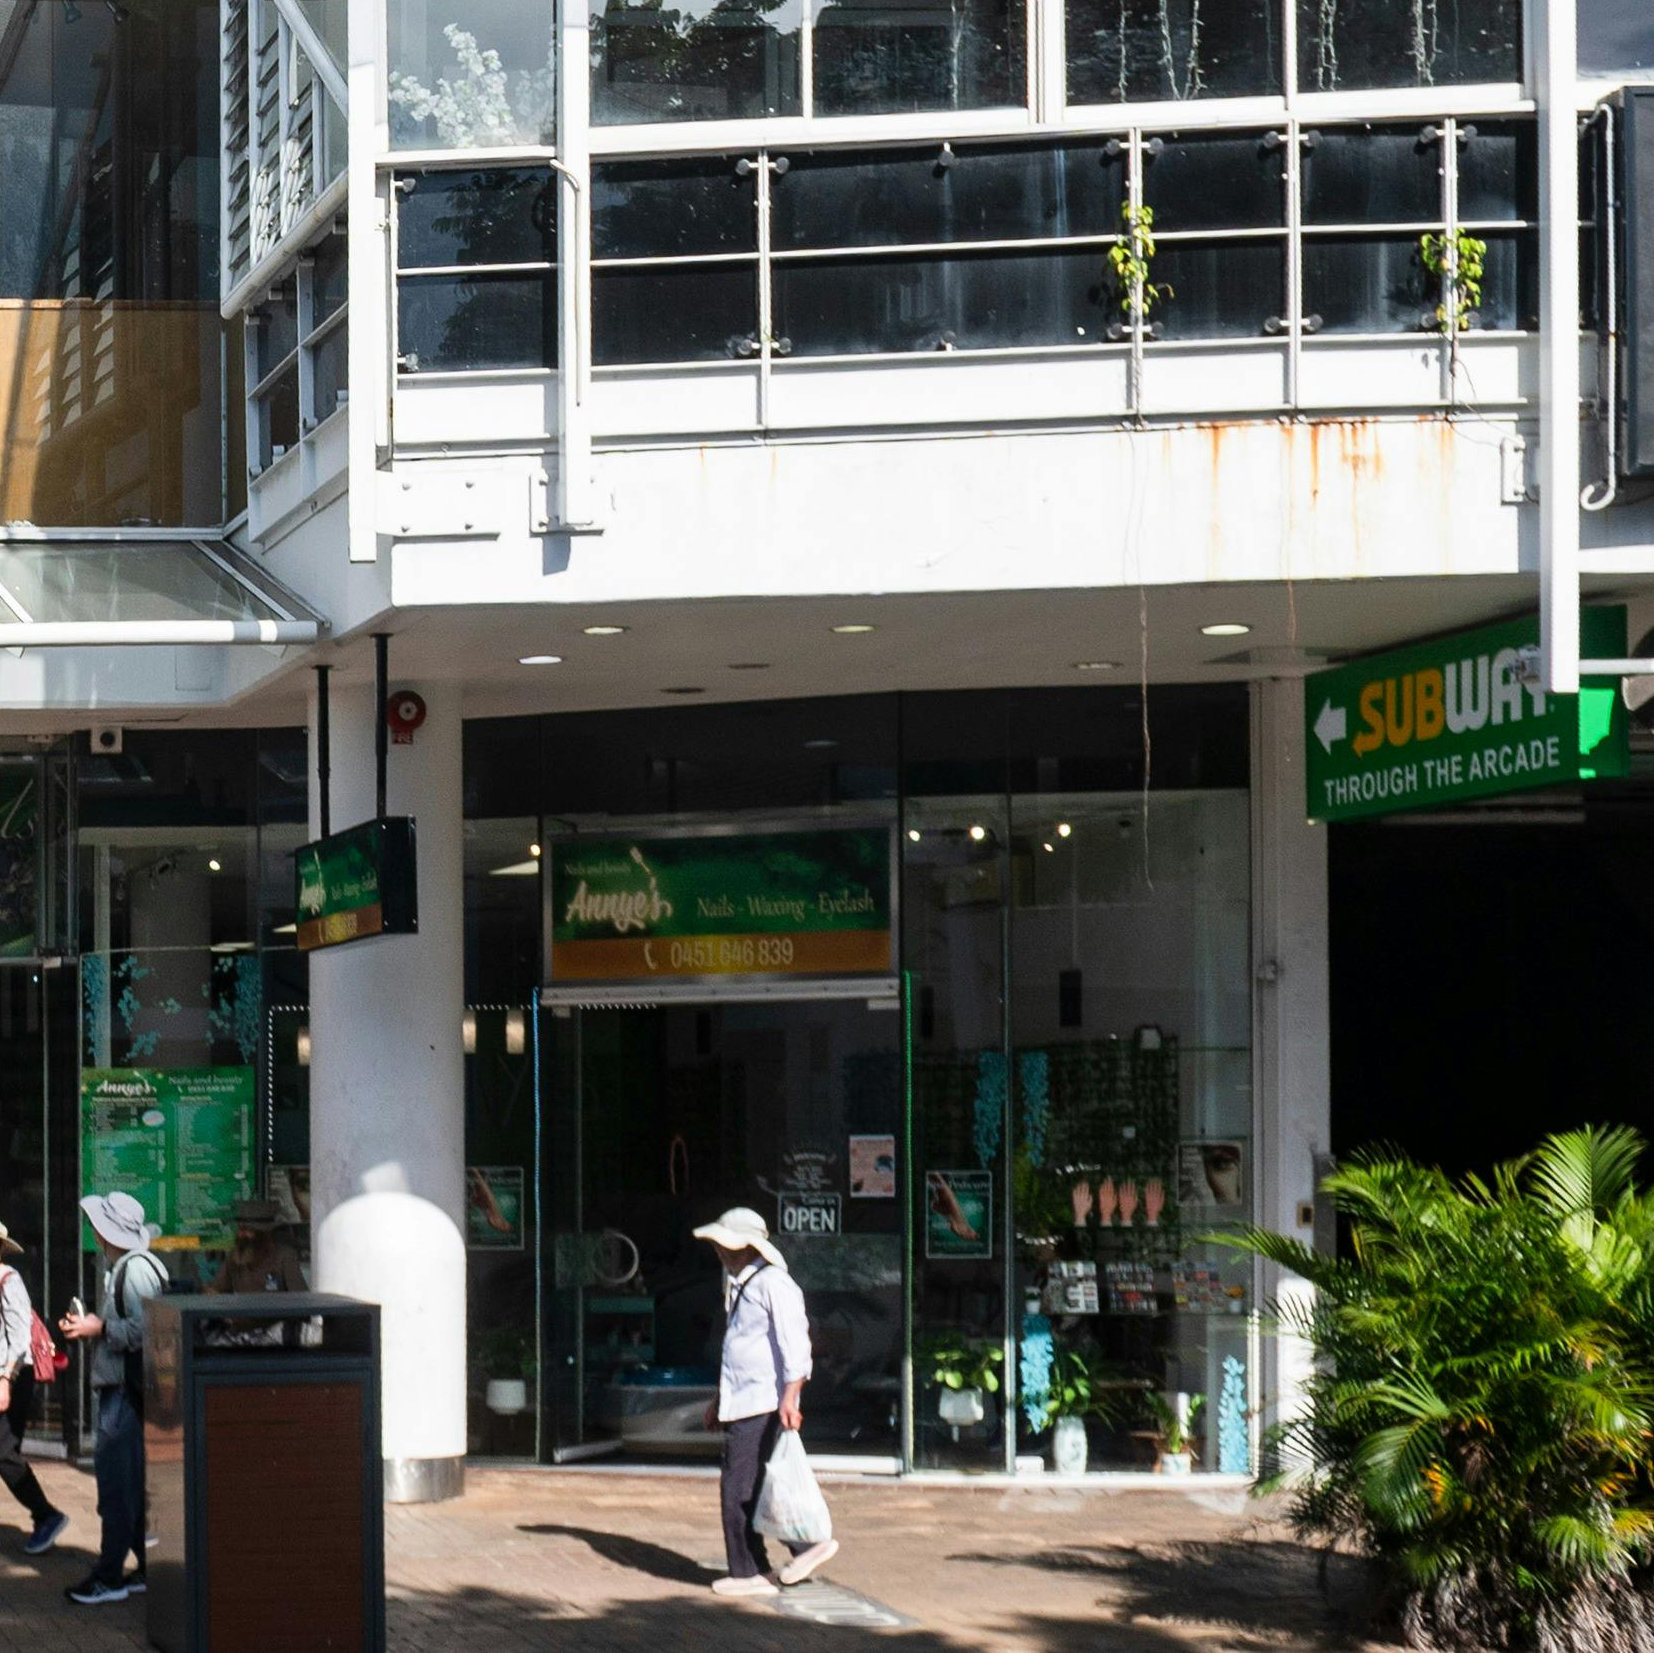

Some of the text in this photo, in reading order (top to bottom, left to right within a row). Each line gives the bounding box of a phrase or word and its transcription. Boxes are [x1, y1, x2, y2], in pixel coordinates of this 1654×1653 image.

[1324, 736, 1560, 808] THROUGH THE ARCADE
[697, 896, 734, 917] Nails
[746, 895, 805, 922] Waxing
[819, 889, 875, 921] Eyelash
[671, 938, 794, 968] 0451 646 839
[784, 1206, 835, 1232] OPEN
